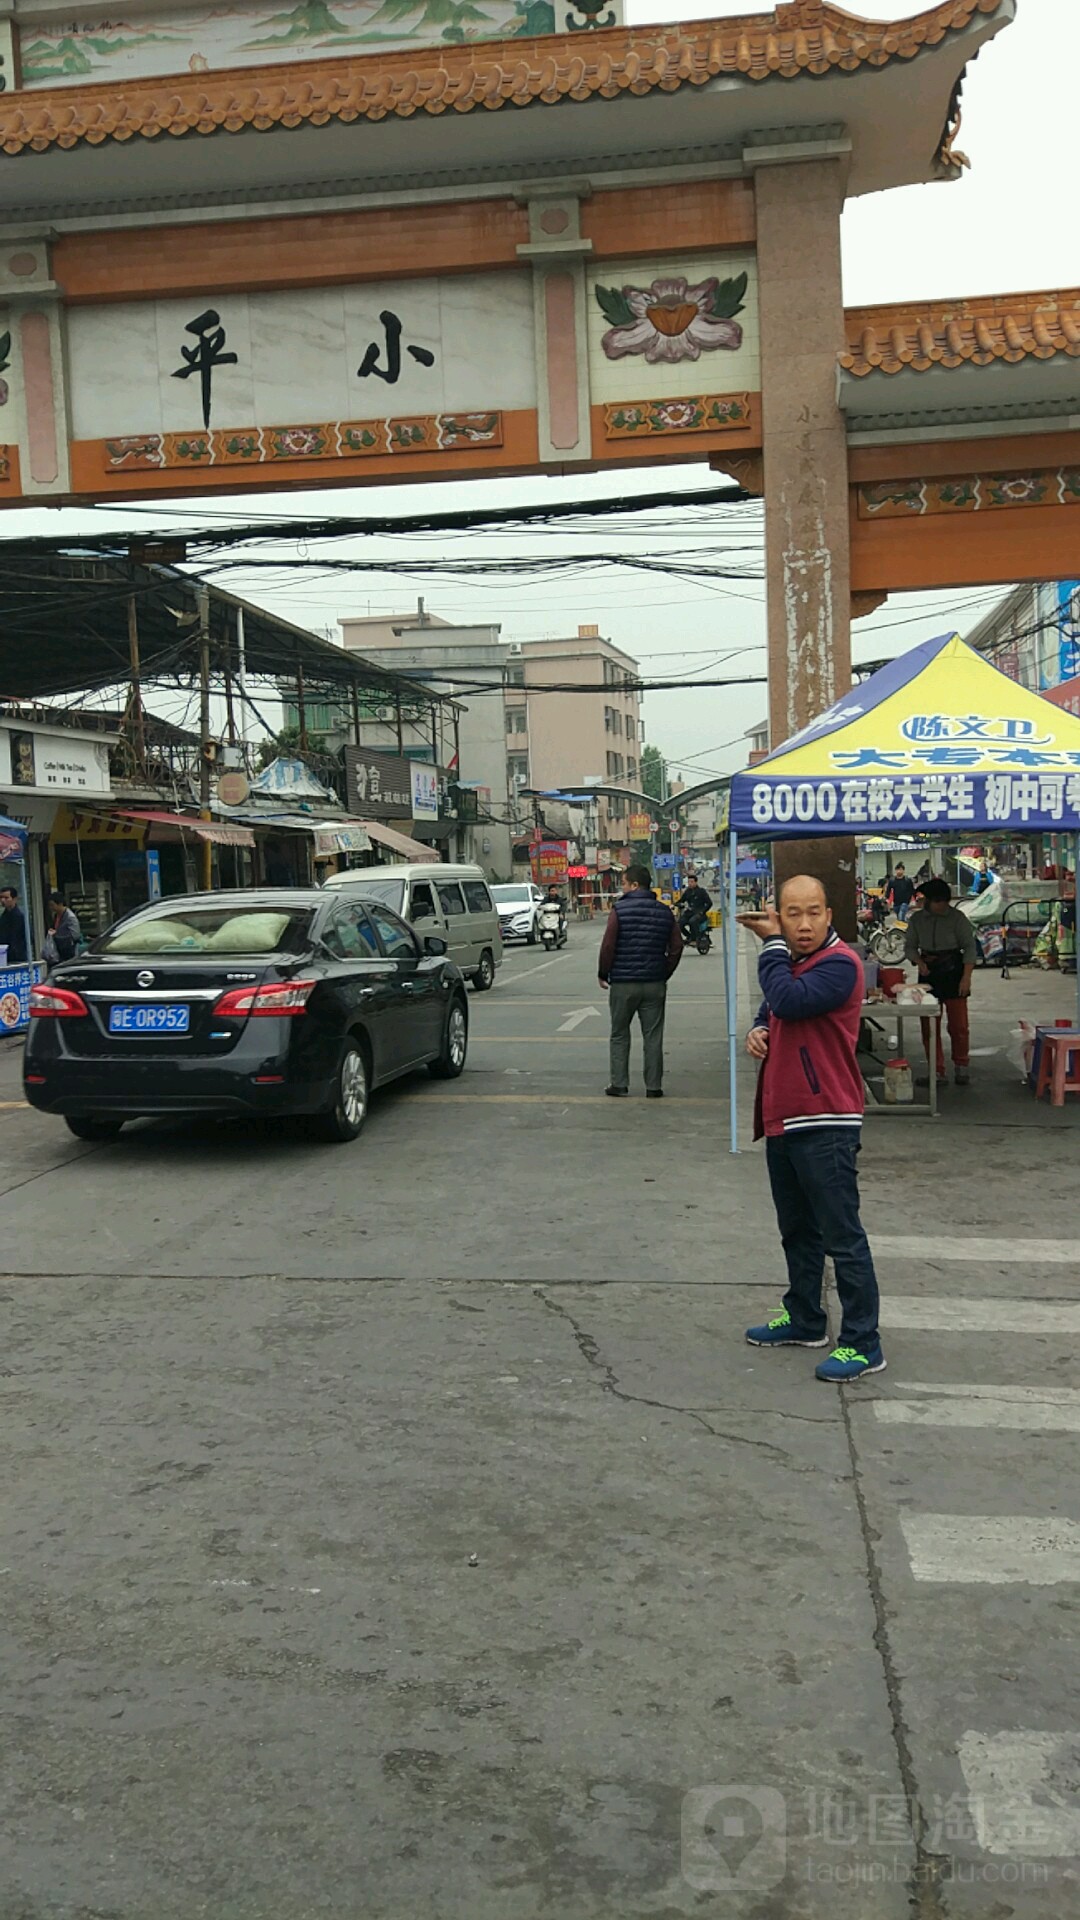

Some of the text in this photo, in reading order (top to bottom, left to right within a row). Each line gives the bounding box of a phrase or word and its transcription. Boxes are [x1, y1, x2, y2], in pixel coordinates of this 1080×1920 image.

[906, 716, 1034, 740] 陈文卫
[832, 747, 1080, 768] 大专本
